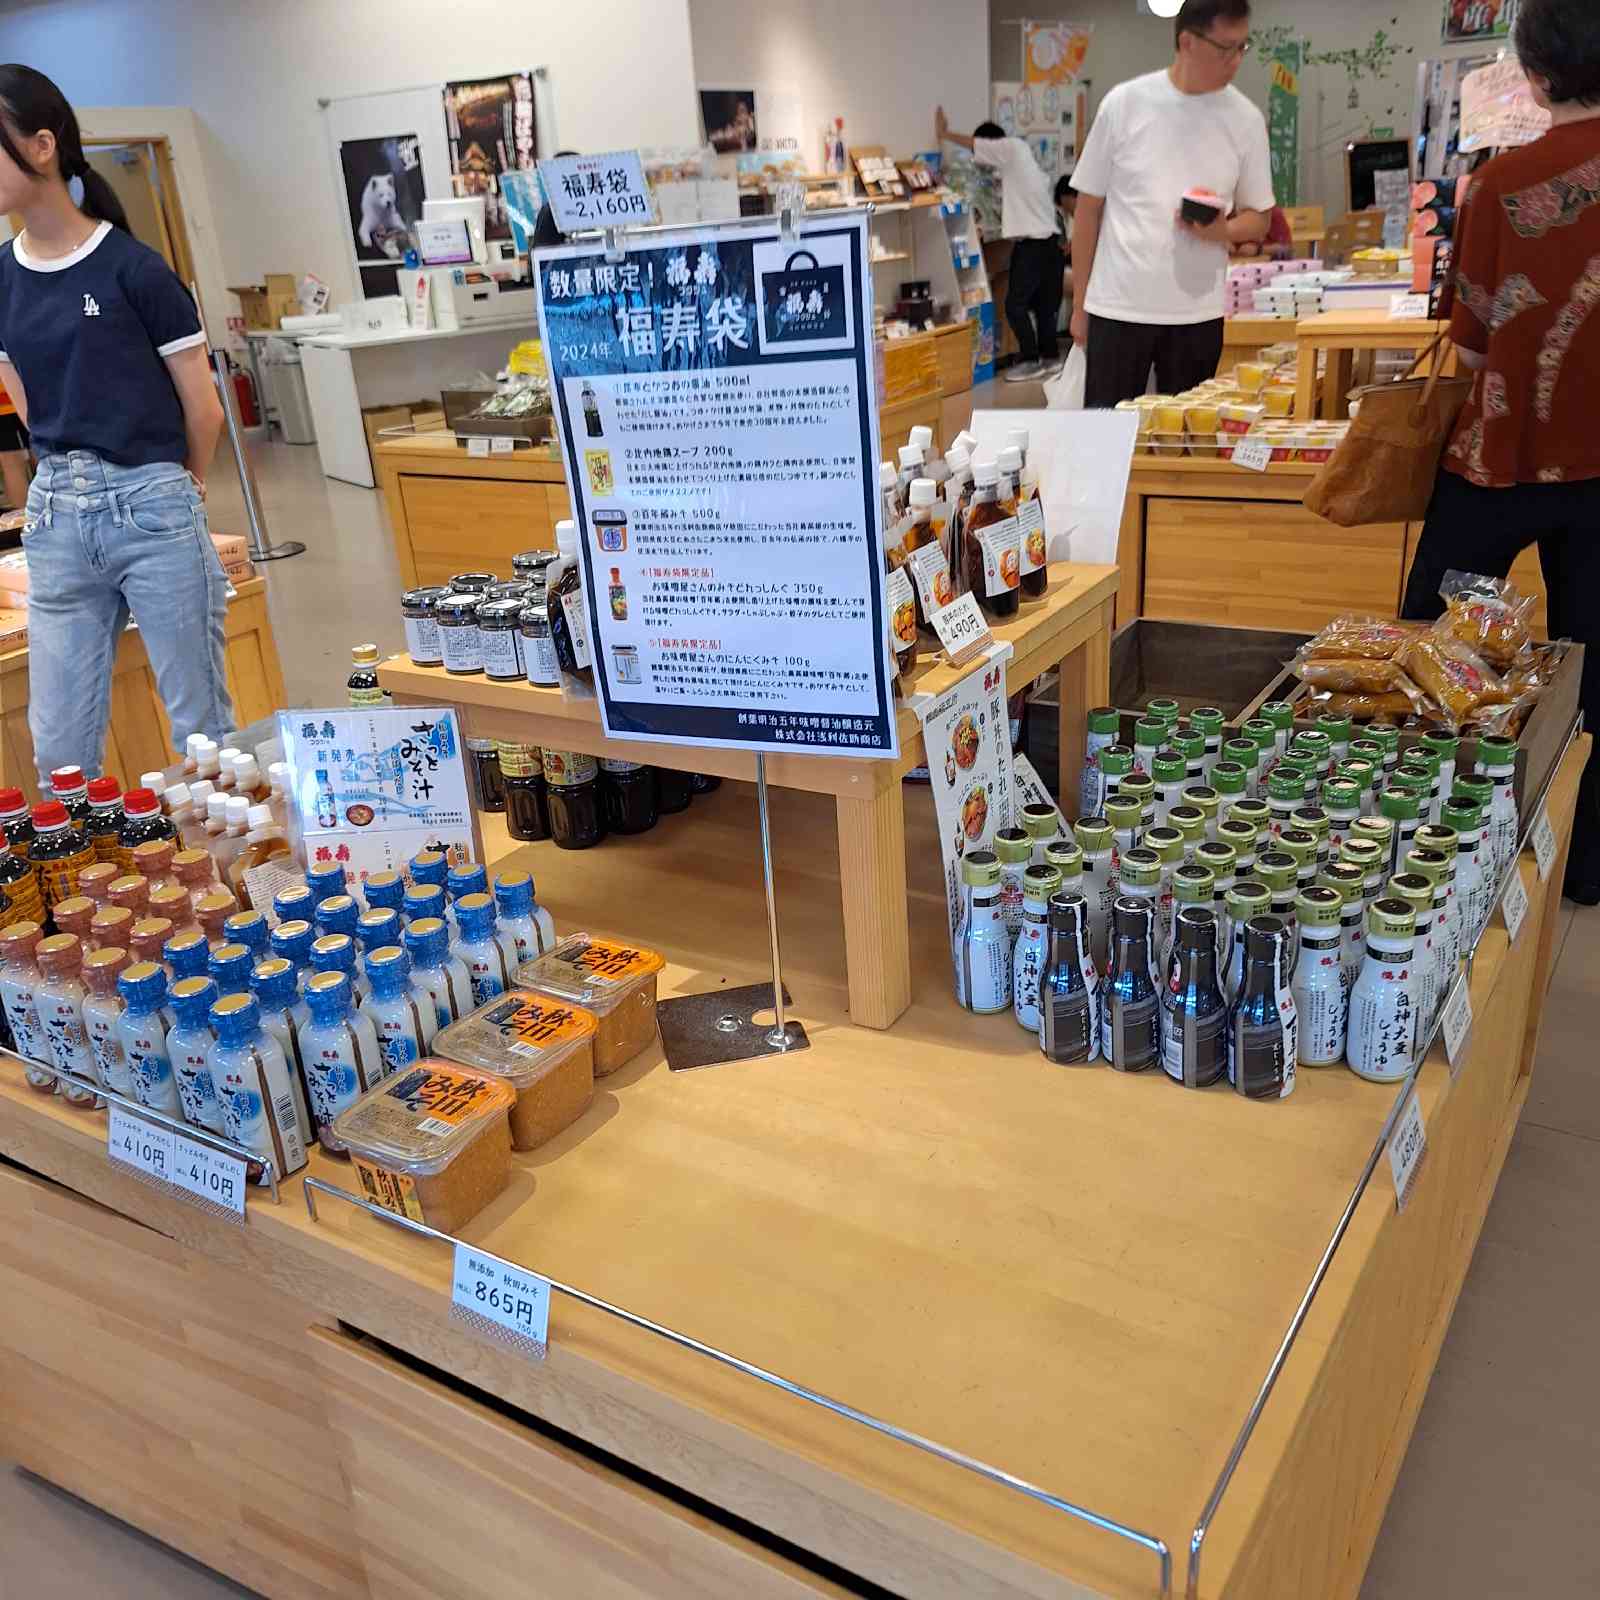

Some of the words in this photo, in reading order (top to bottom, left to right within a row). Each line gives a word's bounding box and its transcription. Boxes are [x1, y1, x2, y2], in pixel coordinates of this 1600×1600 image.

[562, 168, 631, 199] 福寿袋
[575, 194, 646, 220] 2,160円
[83, 294, 100, 316] LA
[615, 297, 749, 357] 福寿袋
[559, 342, 611, 361] 2024年
[716, 374, 751, 387] 500ml
[704, 445, 734, 457] 200g
[693, 508, 721, 520] 500g
[794, 583, 823, 594] 350g
[950, 612, 980, 641] 490円
[784, 656, 811, 667] 100g
[410, 720, 440, 772] さっと
[400, 739, 435, 801] みそ汁
[1391, 990, 1412, 1057] 白神大豆
[1374, 1018, 1391, 1066] しょうゆ
[124, 1135, 165, 1169] 410円
[190, 1164, 234, 1199] 410円
[468, 1258, 495, 1279] 無添加
[504, 1273, 540, 1299] 秋田みそ
[475, 1280, 534, 1326] 865円
